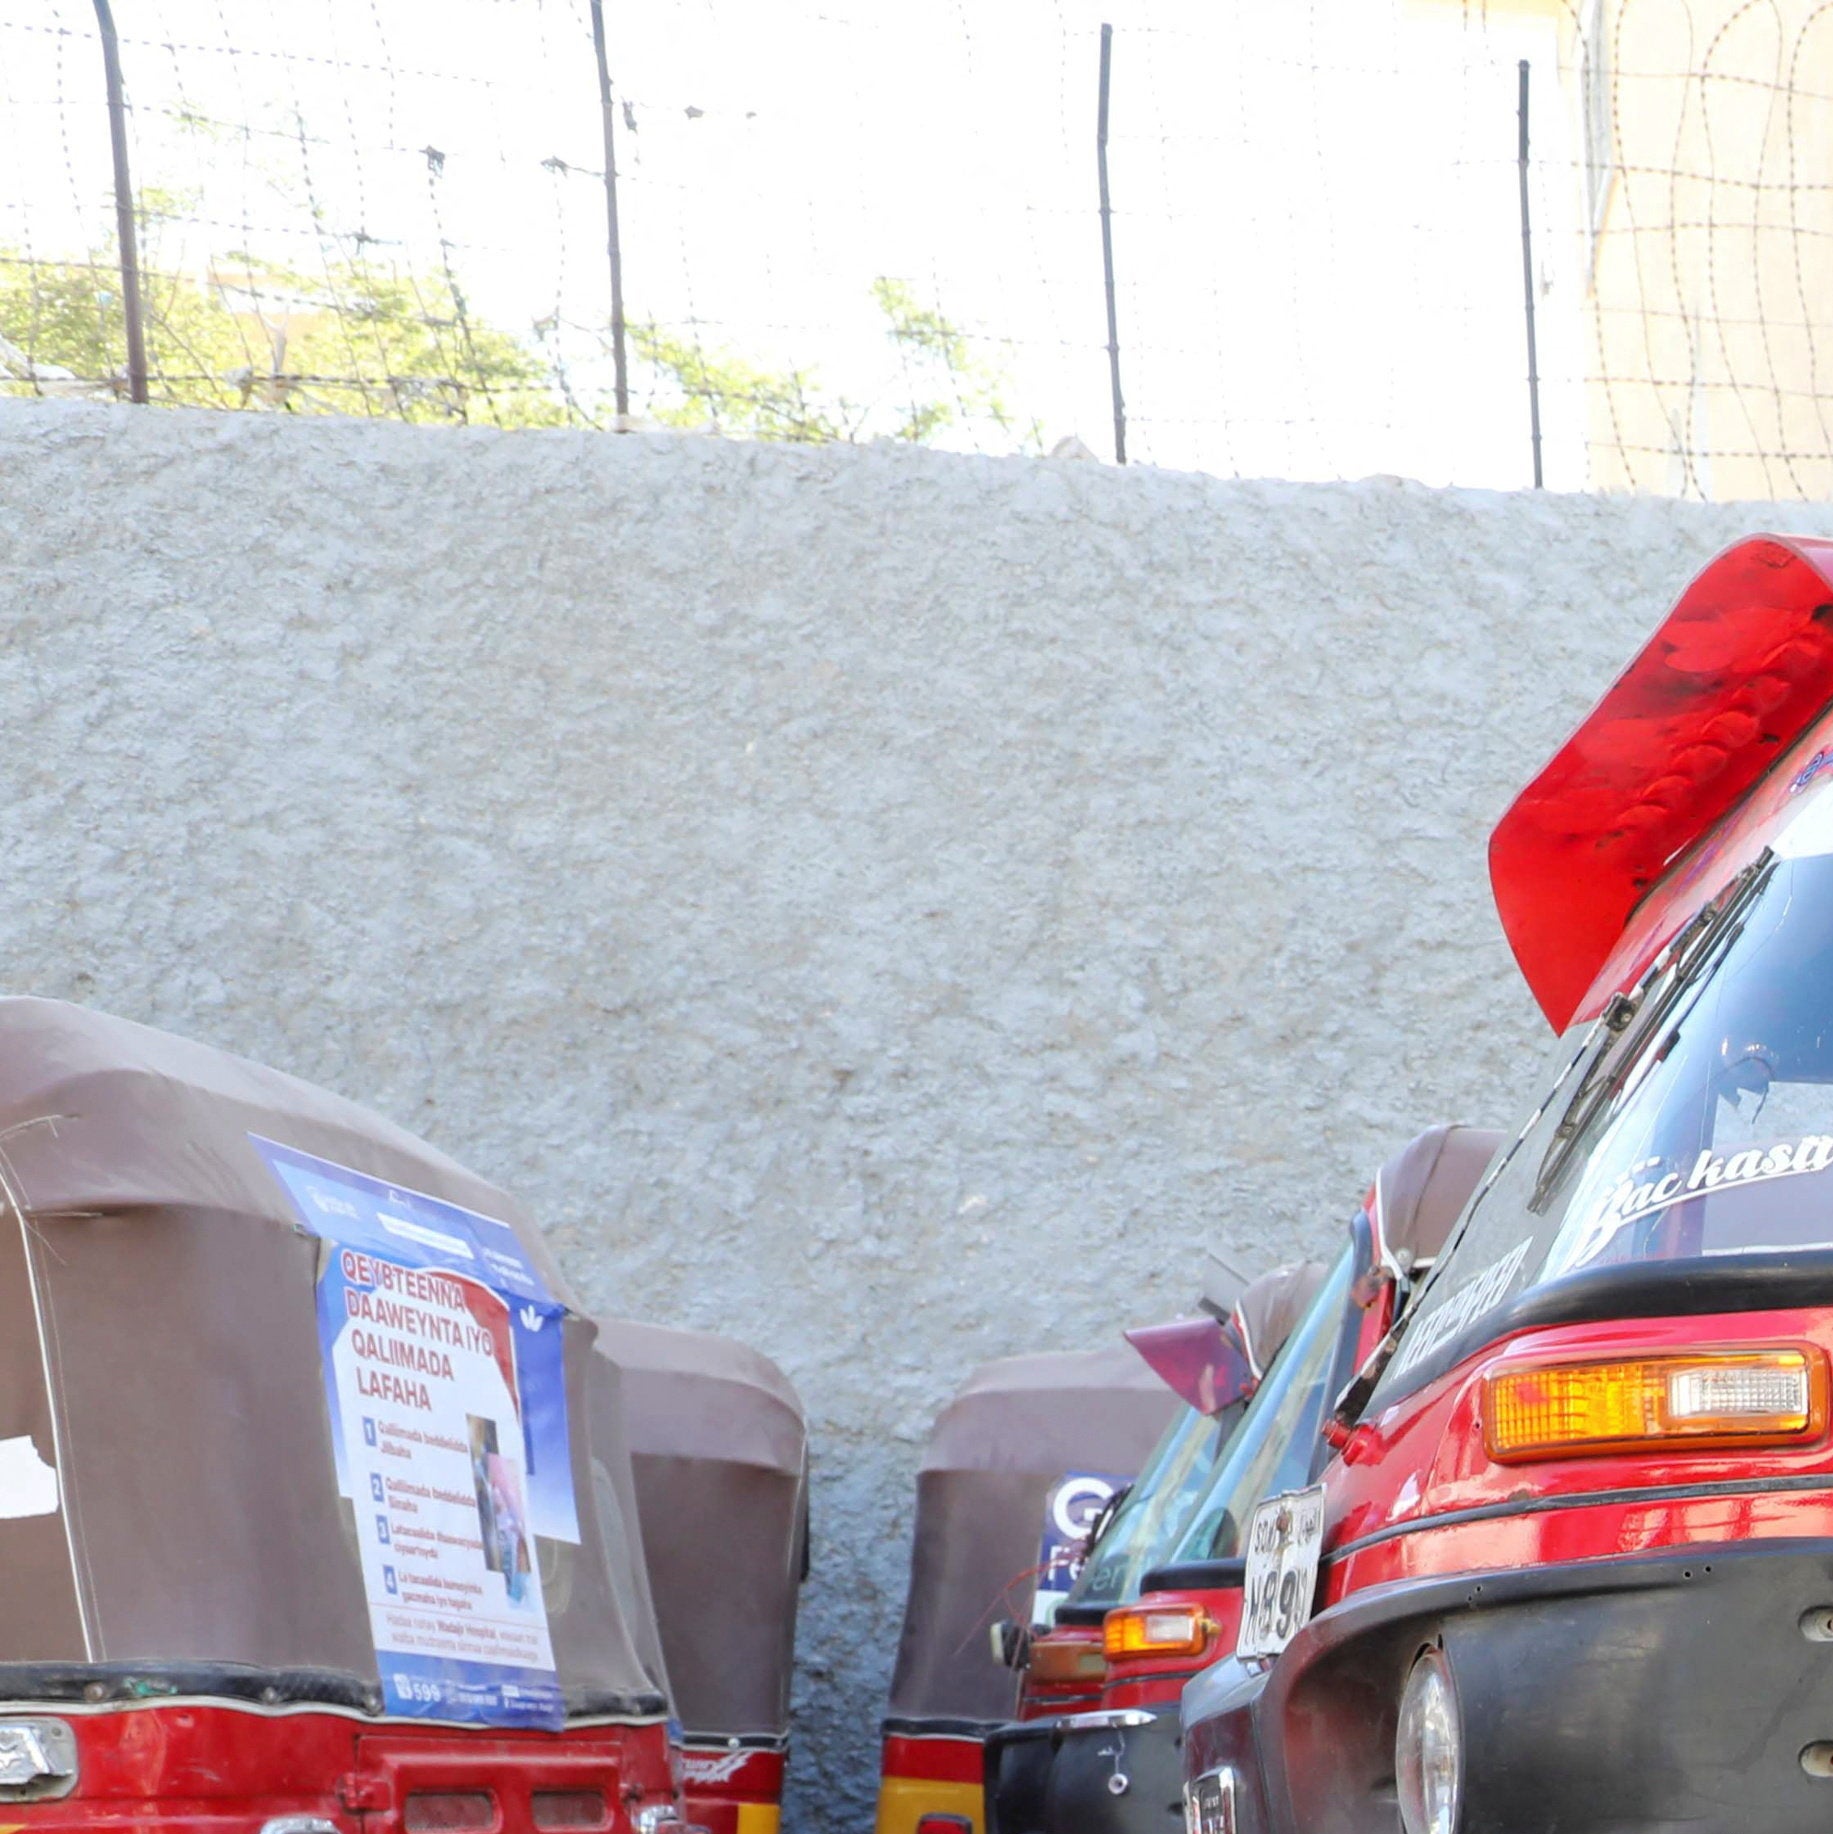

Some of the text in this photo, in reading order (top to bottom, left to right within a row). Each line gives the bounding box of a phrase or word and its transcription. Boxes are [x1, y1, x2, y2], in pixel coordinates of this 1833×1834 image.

[342, 1251, 466, 1313] QEYBTEENNA
[346, 1289, 493, 1357] DAAWEYNTA IYO
[351, 1329, 455, 1381] QALIIMADA
[356, 1366, 432, 1411] LAFAHA
[413, 1684, 441, 1702] 599
